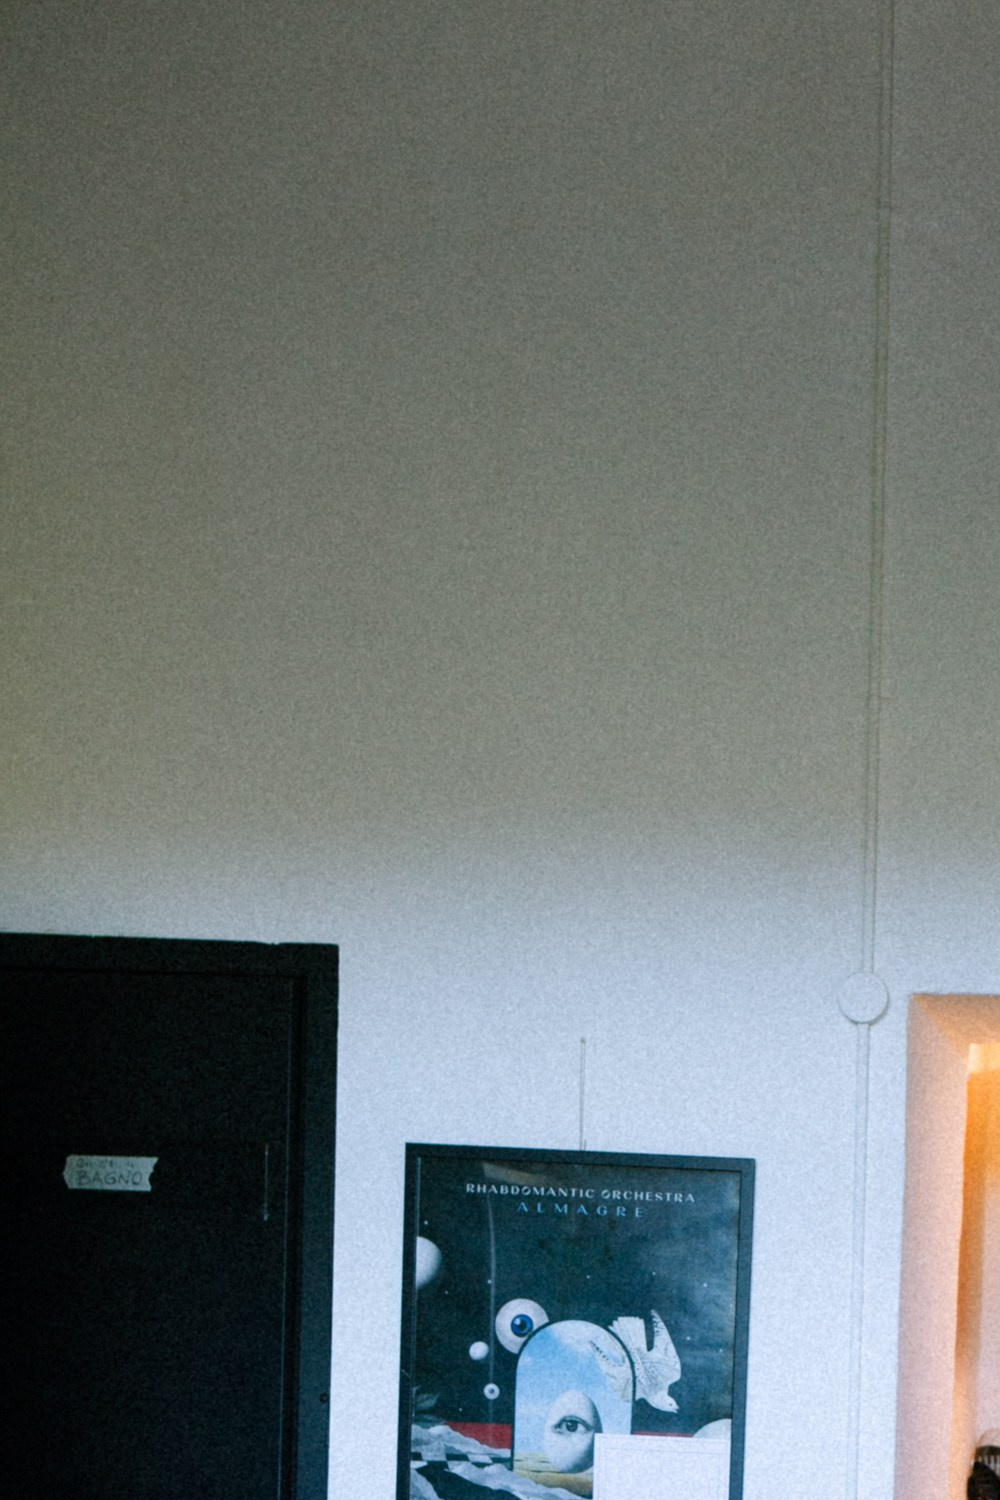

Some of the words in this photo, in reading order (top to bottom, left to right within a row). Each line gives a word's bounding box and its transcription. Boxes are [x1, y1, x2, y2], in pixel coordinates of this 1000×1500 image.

[77, 1169, 143, 1186] BAGNO
[465, 1183, 595, 1199] RHABDOMANTIC
[601, 1188, 696, 1203] ORCHESTRA
[516, 1201, 645, 1218] ALMAGRE
